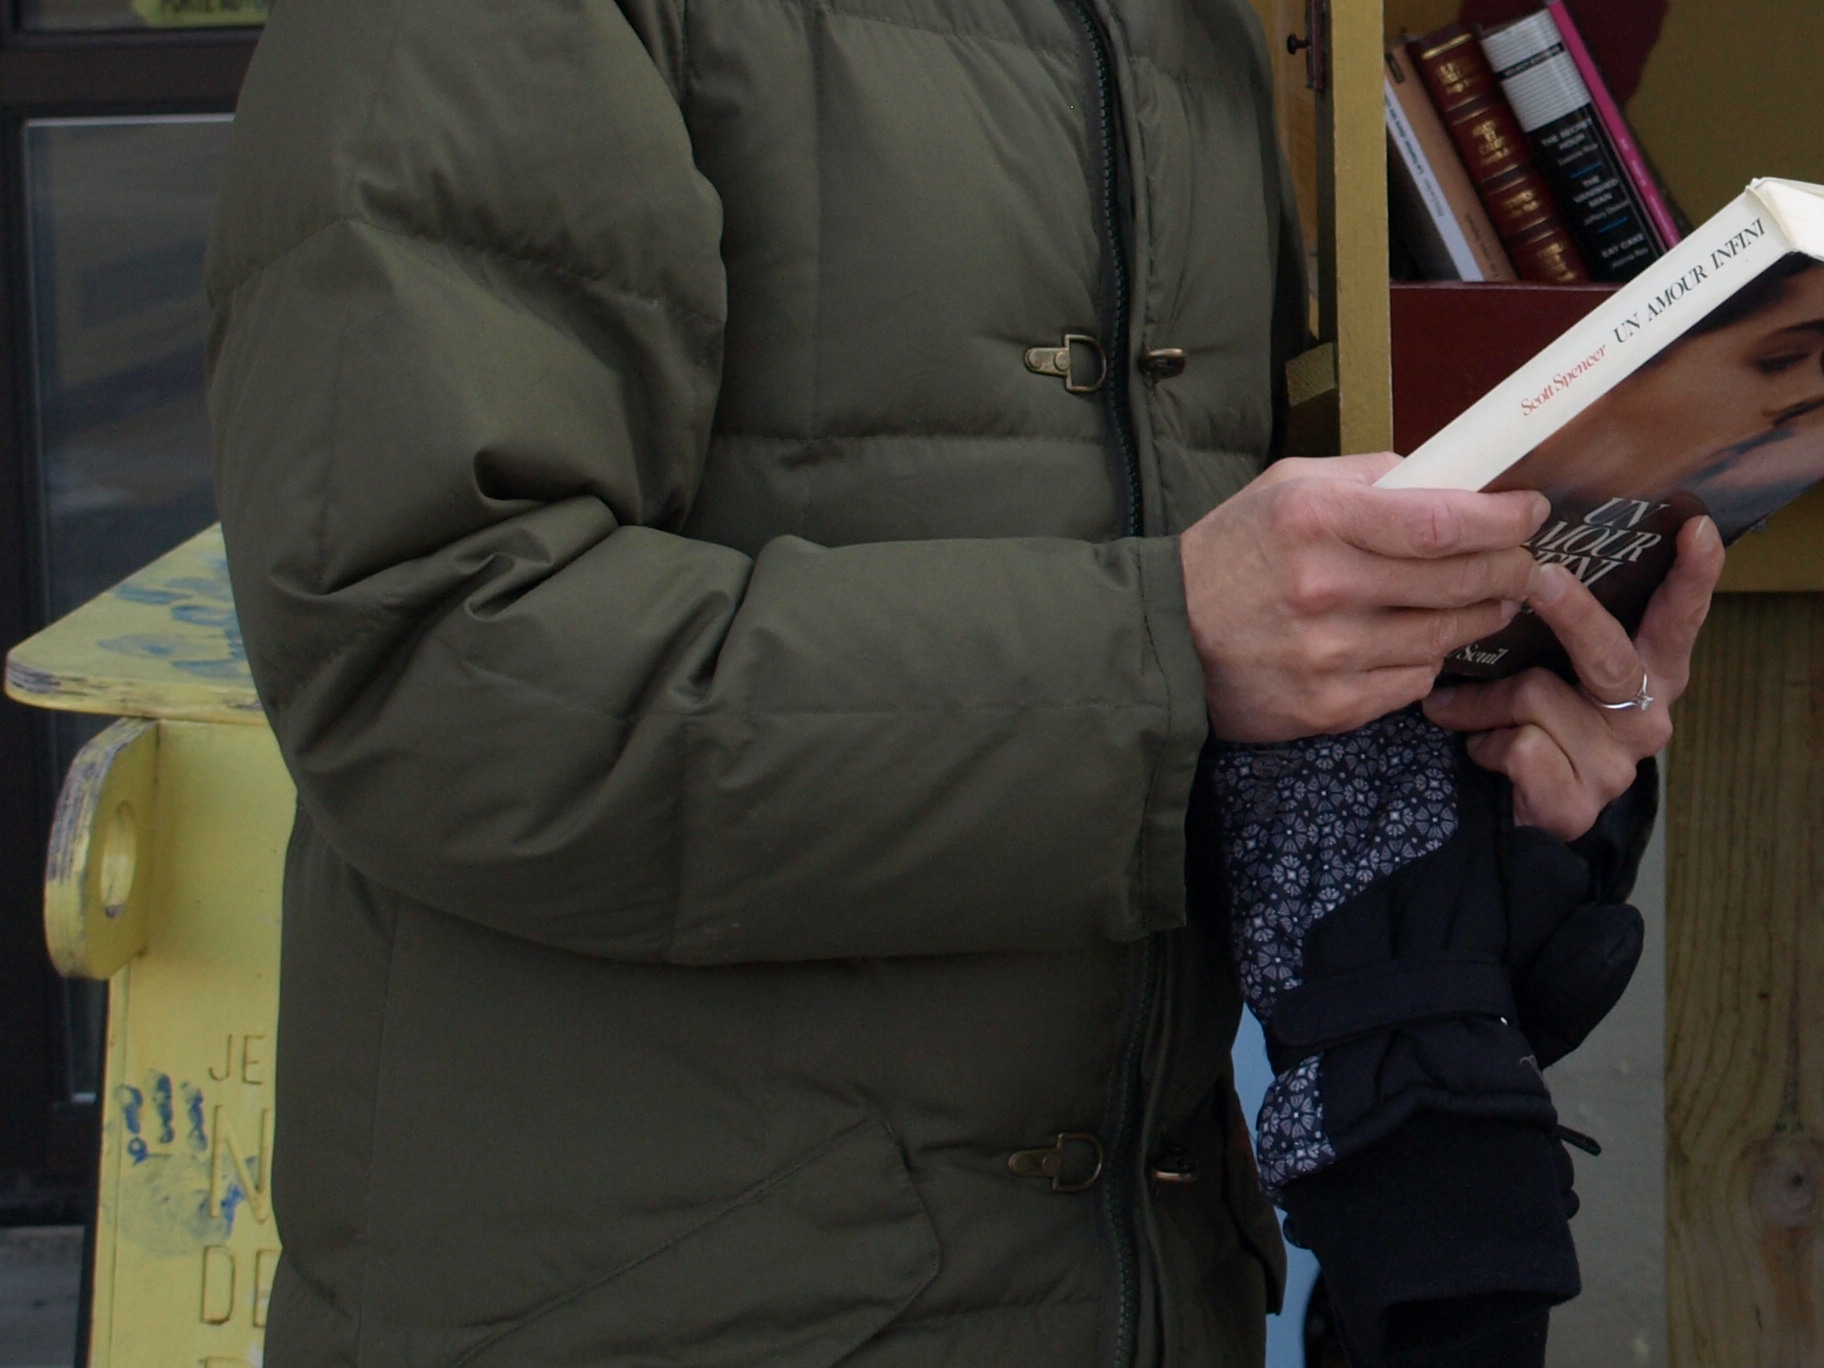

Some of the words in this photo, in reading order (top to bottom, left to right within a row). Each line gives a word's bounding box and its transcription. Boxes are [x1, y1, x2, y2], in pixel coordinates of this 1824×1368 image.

[1612, 312, 1642, 344] UN
[1647, 264, 1708, 322] AMOUR
[1710, 217, 1766, 270] INFINI
[1520, 383, 1555, 417] Scott
[1552, 343, 1607, 393] Spencer
[1584, 497, 1672, 529] UN
[1520, 520, 1662, 563] MOUR
[208, 1033, 266, 1085] JE
